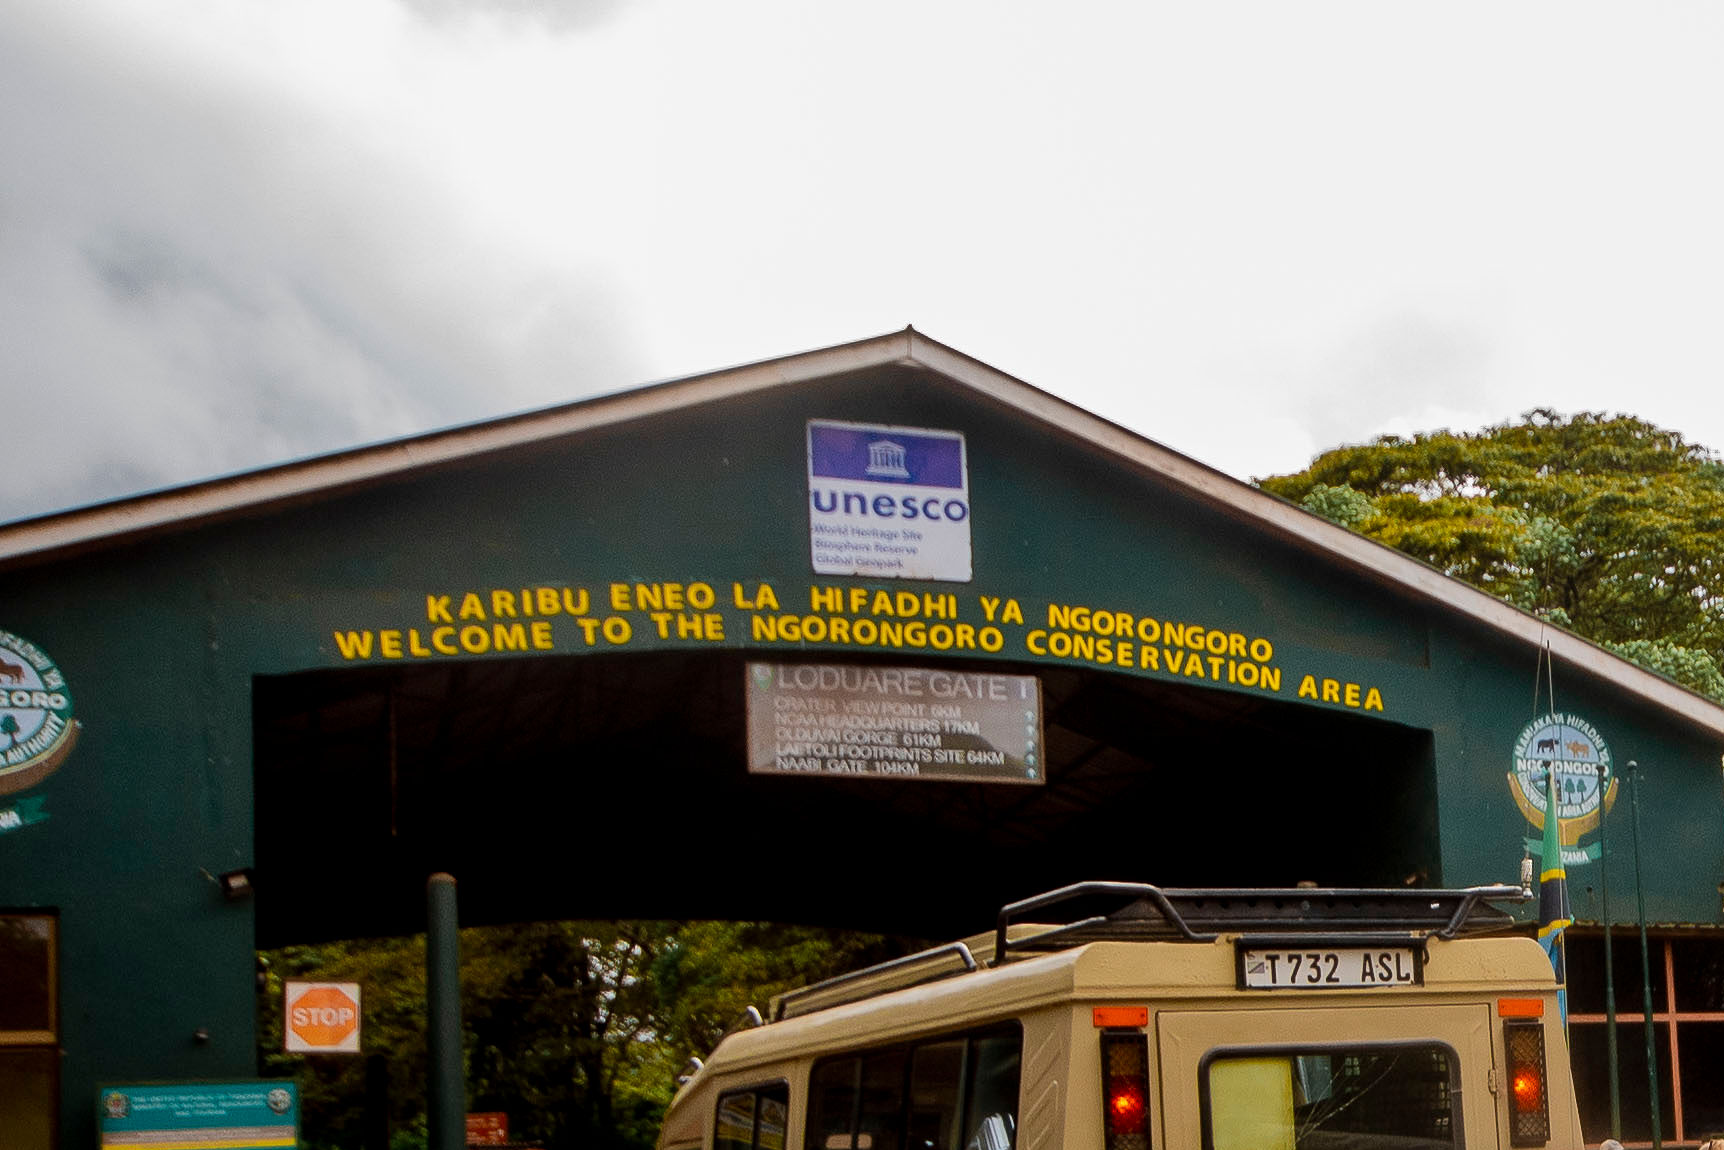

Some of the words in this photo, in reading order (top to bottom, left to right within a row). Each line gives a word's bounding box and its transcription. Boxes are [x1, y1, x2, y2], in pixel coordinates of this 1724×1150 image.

[813, 489, 967, 522] unesco
[427, 587, 590, 624] KARIBU
[609, 581, 716, 611] ENEO
[733, 582, 779, 611] LA
[810, 585, 958, 620] HIFADHI
[980, 595, 1024, 625] YA
[1048, 603, 1273, 664] NGORONGORO
[334, 621, 554, 660] WELCOME
[577, 616, 633, 646] TO
[651, 612, 725, 642] THE
[752, 614, 1004, 652] NGORONGORO
[1026, 629, 1281, 692] CONSERVATION
[1298, 674, 1384, 713] AREA
[778, 665, 924, 697] LODUARE
[929, 671, 1008, 701] GATE
[903, 733, 942, 748] 61KM
[827, 758, 867, 774] GATE
[935, 749, 966, 764] SITE
[1361, 952, 1411, 983] ASL
[293, 1007, 354, 1027] STOP
